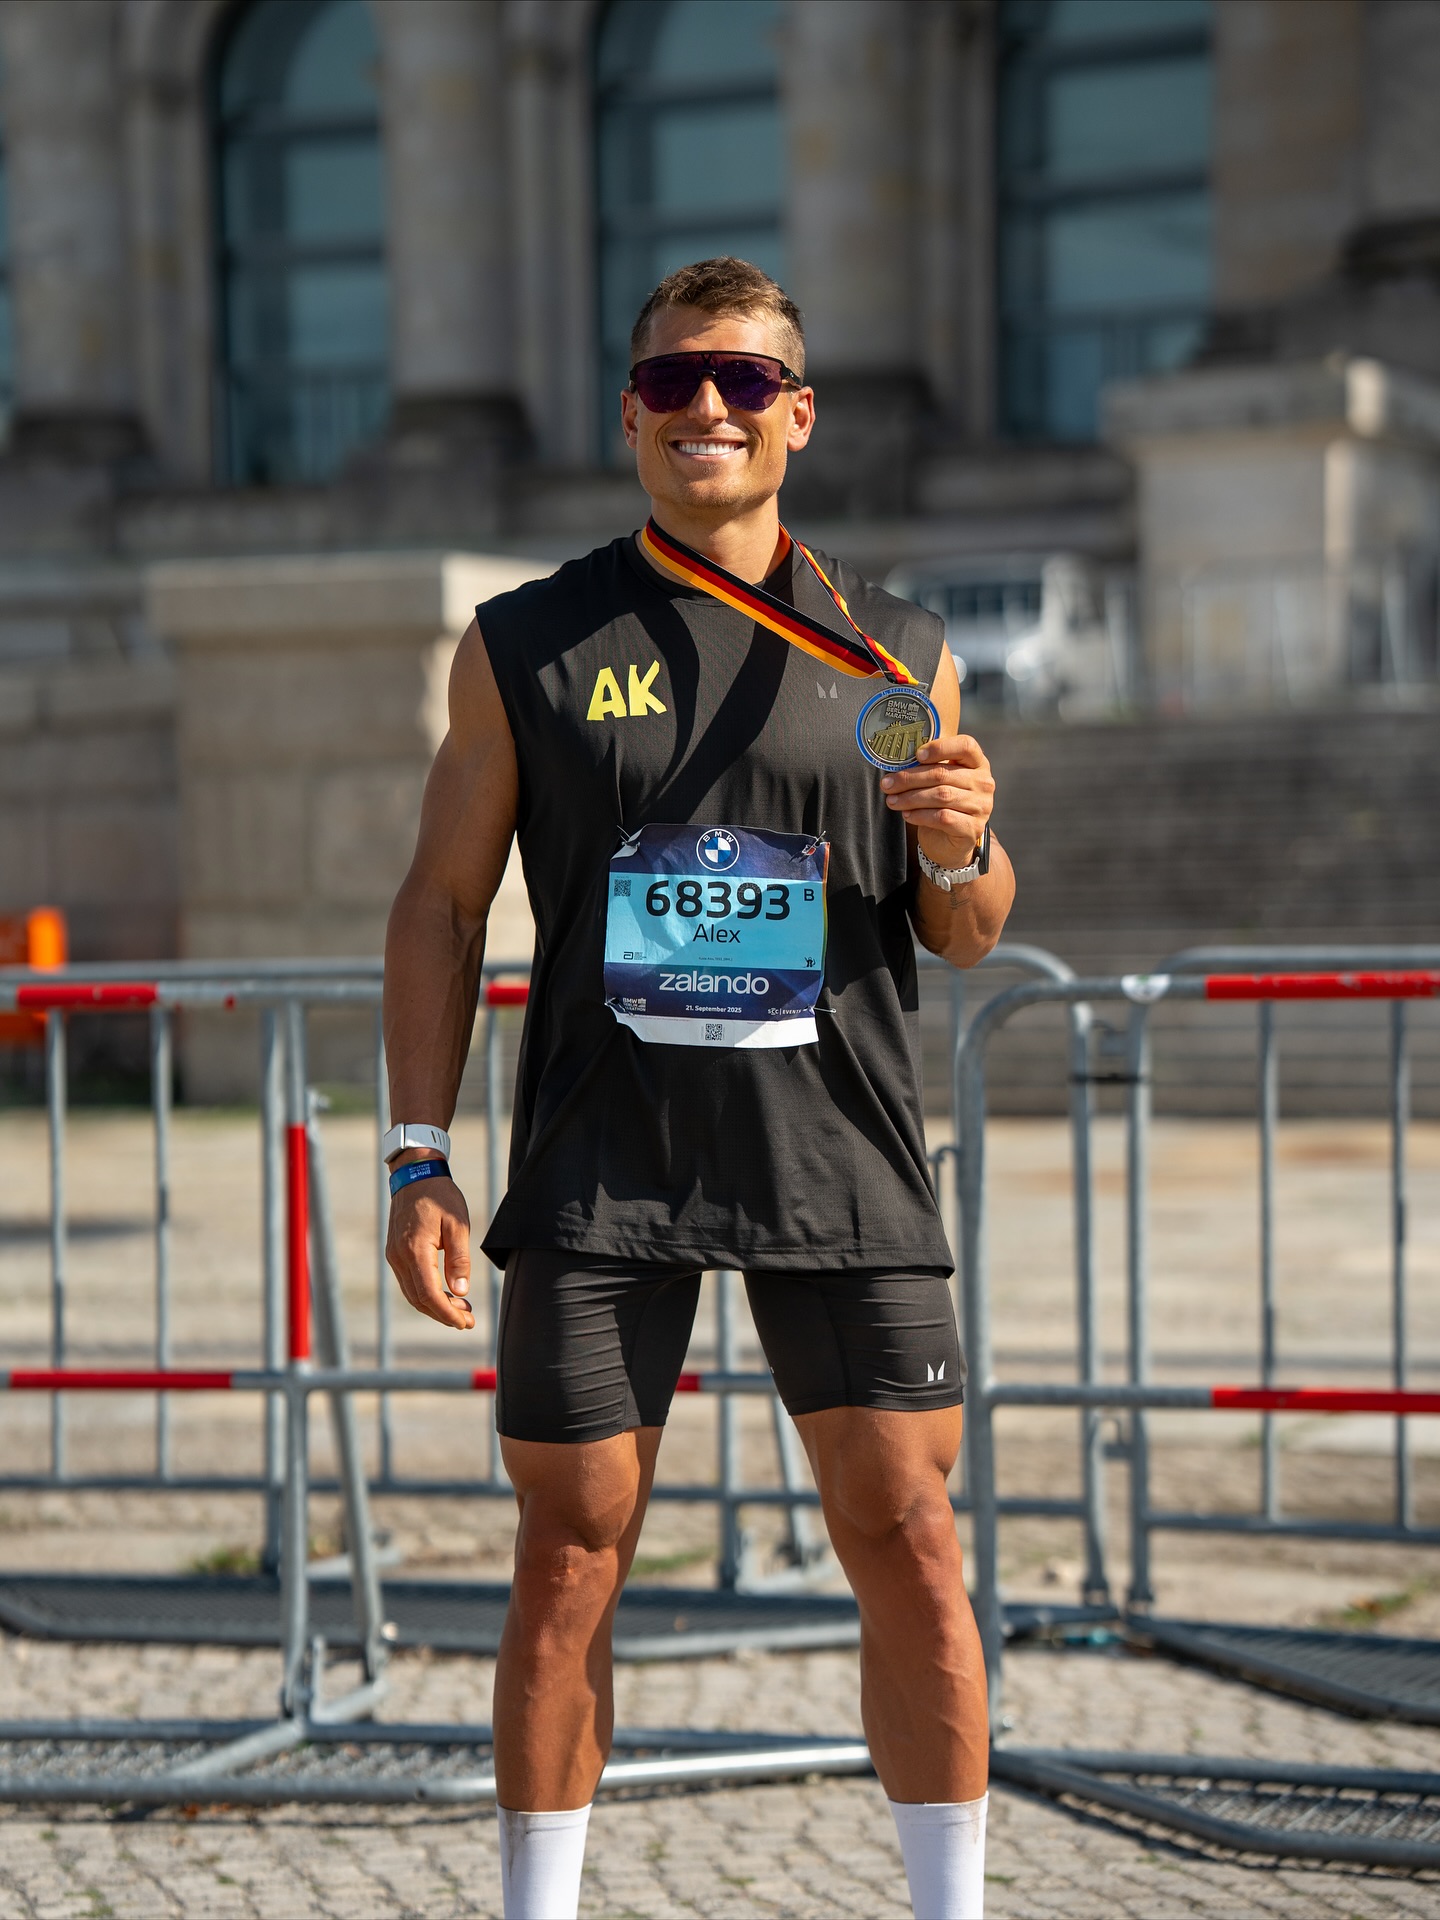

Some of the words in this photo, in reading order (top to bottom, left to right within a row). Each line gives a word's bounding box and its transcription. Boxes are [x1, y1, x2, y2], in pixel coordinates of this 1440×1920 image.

[586, 659, 667, 721] AK
[886, 706, 907, 715] BERLIN
[887, 700, 908, 710] BMW
[885, 711, 918, 721] MARATHON
[703, 831, 734, 843] BMW
[645, 879, 791, 921] 68393
[803, 888, 815, 902] B
[692, 923, 741, 944] Alex
[658, 970, 770, 996] zalando
[694, 1005, 727, 1013] September
[727, 1006, 742, 1014] 2025
